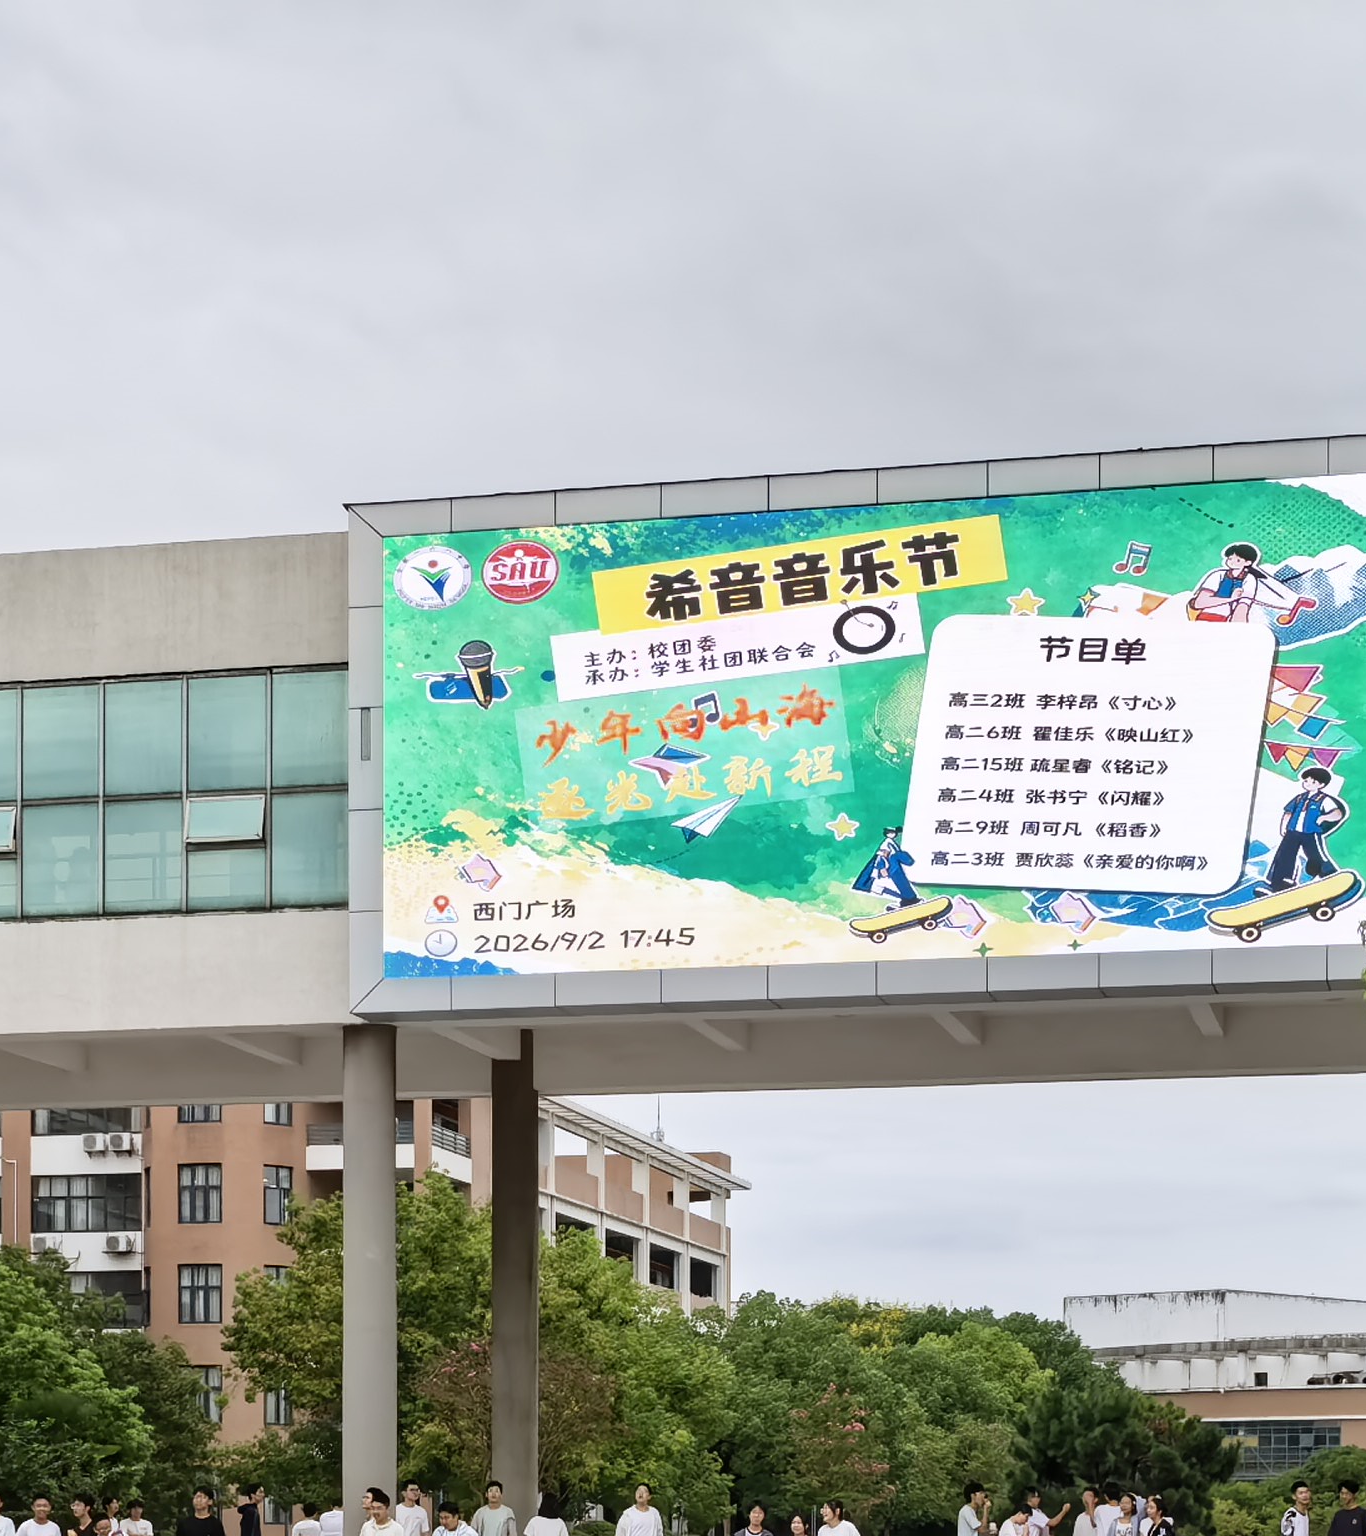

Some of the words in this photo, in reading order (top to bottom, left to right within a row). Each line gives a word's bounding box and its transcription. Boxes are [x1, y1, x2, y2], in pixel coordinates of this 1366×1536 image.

[645, 531, 960, 621] 希音音乐节
[1039, 635, 1147, 665] 节目单
[948, 691, 1026, 709] 高三2班
[535, 682, 835, 769] 少年向山海
[944, 724, 1023, 740] 高二6班
[940, 756, 1025, 772] 高二15班
[937, 787, 1016, 804] 高二4班
[934, 819, 1010, 836] 高二9班
[930, 850, 1006, 868] 高二3班
[472, 898, 576, 922] 西门广场
[473, 930, 606, 954] 2026/9/2
[619, 927, 696, 949] 17:45
